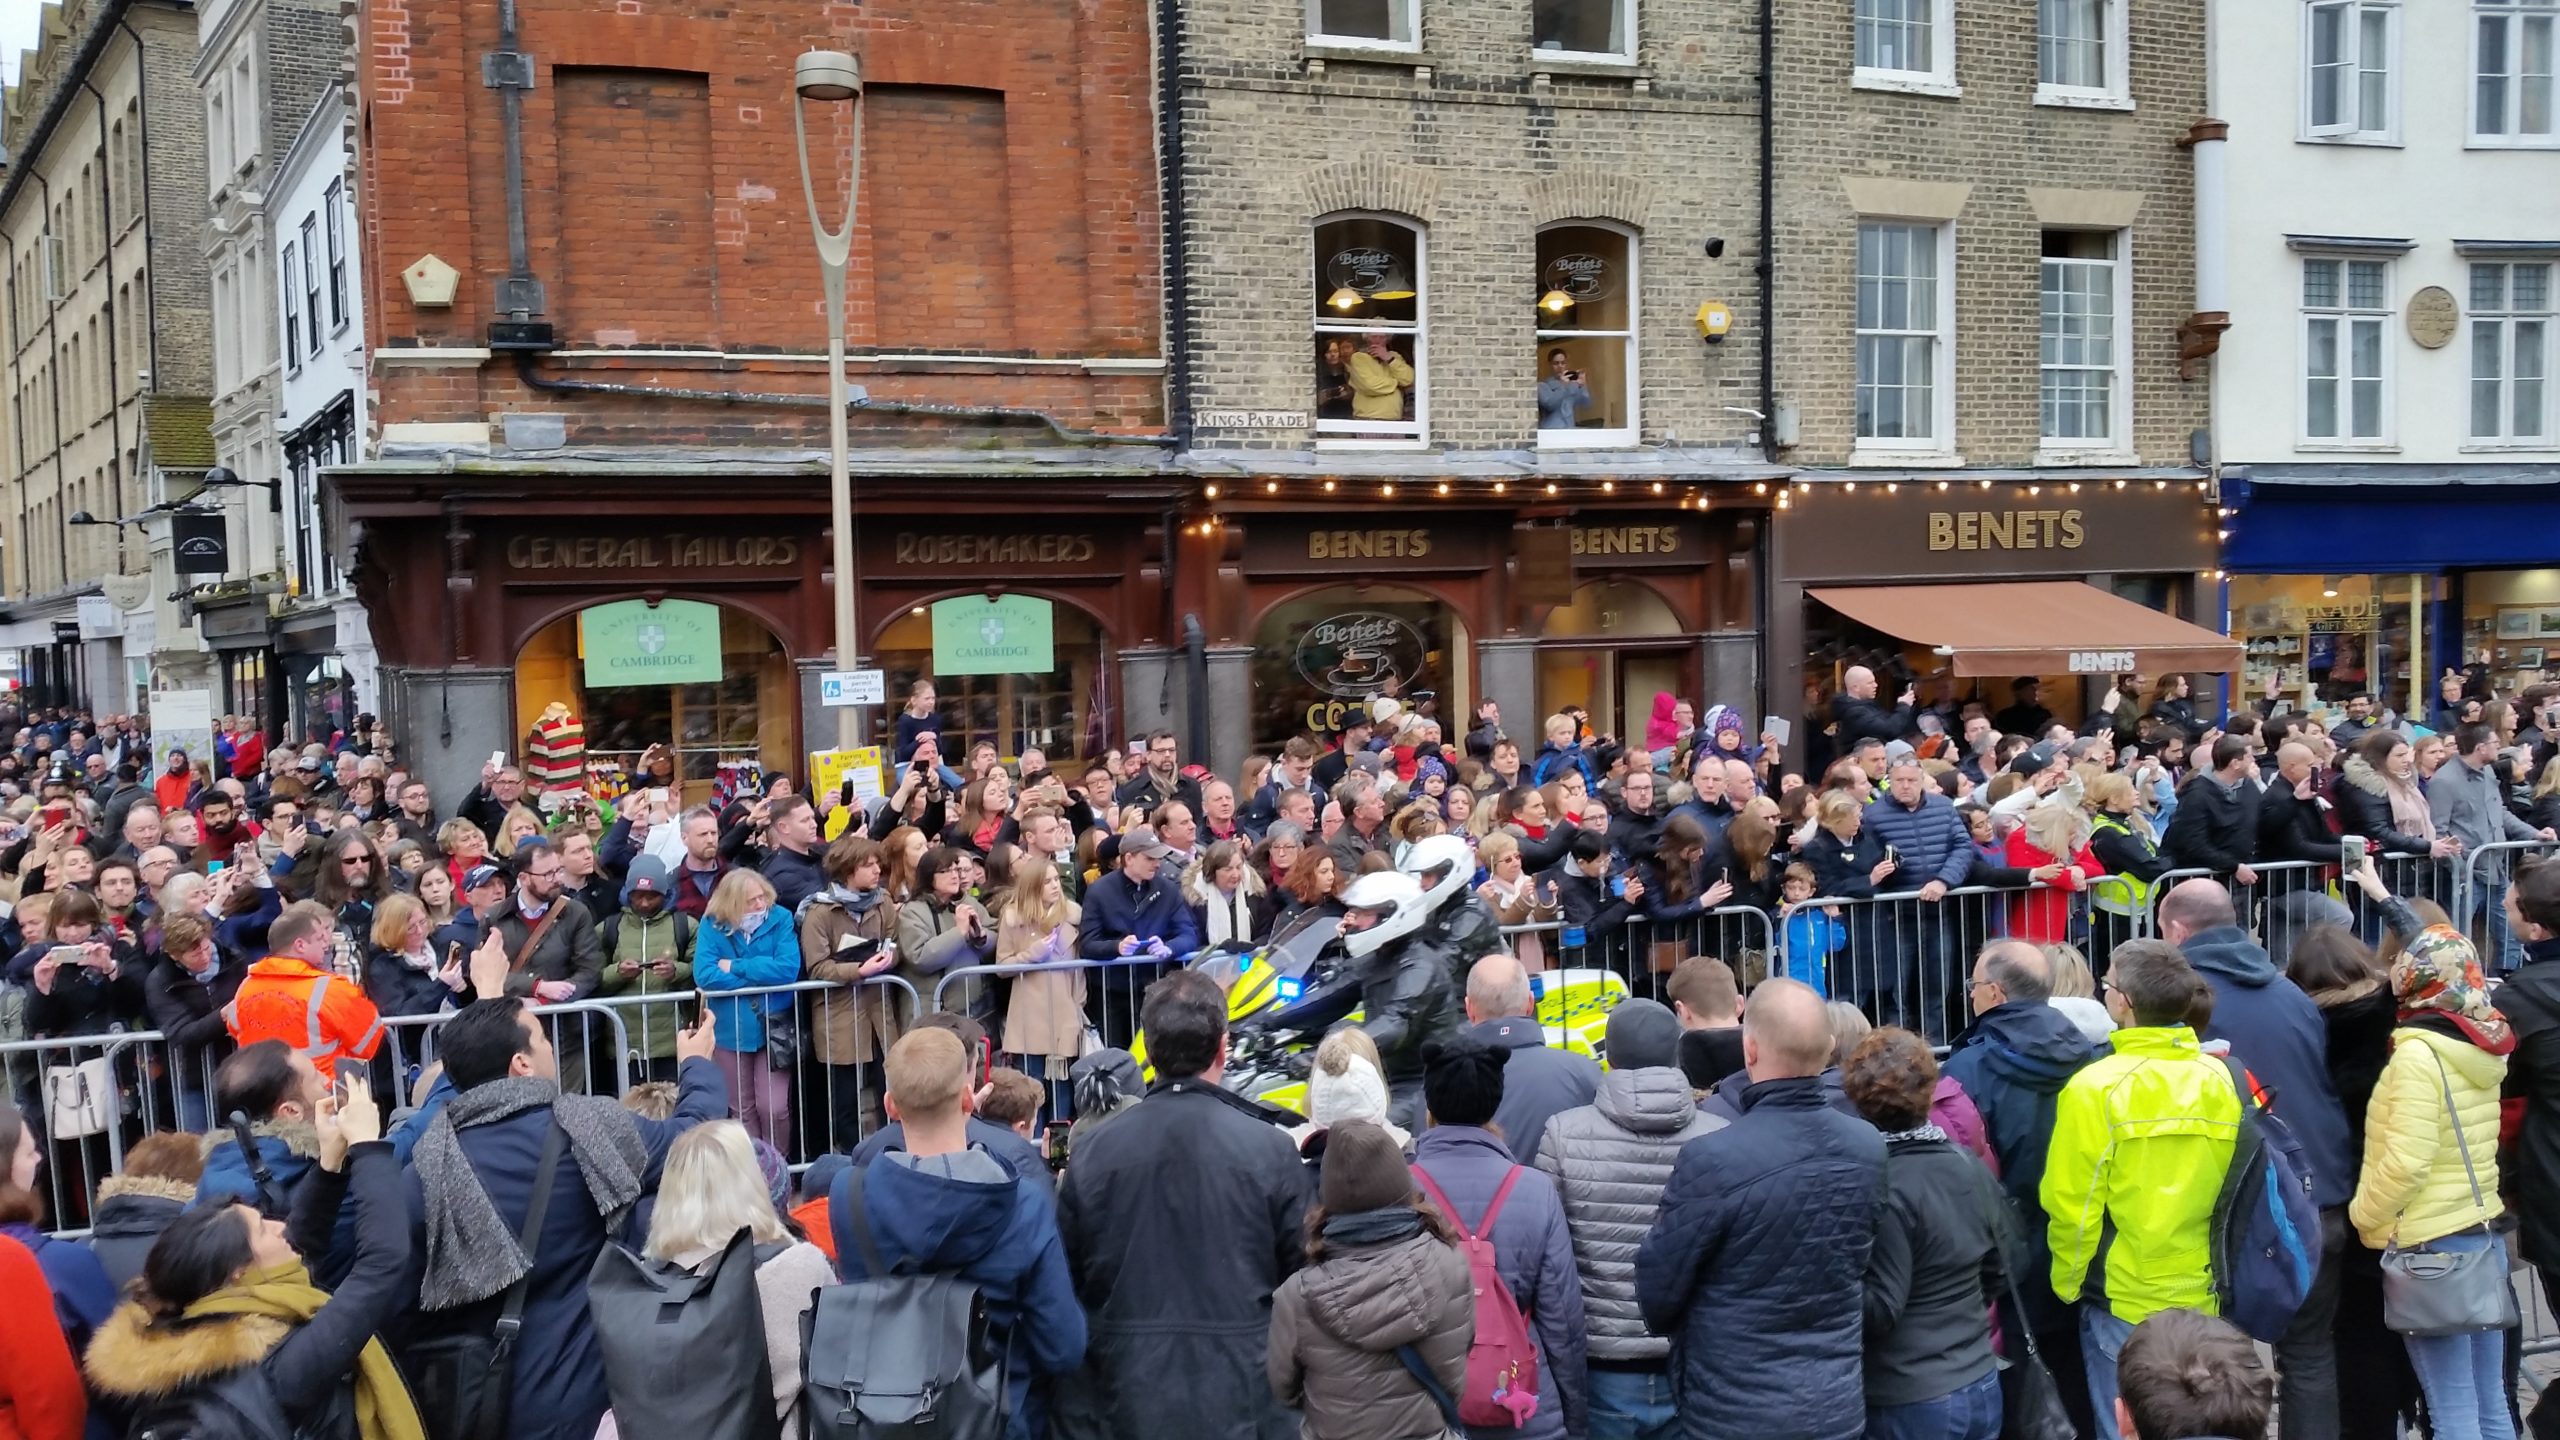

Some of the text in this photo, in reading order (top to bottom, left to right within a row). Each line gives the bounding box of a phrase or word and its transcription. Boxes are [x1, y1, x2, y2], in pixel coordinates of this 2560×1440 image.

[1200, 412, 1305, 427] KINGS PARADE
[1571, 527, 1680, 554] BENETS
[1927, 509, 2085, 550] BENETS
[507, 533, 797, 568] GENERAL TAILORS
[896, 531, 1095, 563] ROBEMAKERS
[1309, 529, 1431, 558] BENETS
[1316, 620, 1398, 645] Benets
[610, 654, 696, 668] CAMBRIDGE
[955, 646, 1029, 657] CAMBRIDGE
[2069, 652, 2135, 671] BENETS
[1541, 991, 1578, 1007] POLCE
